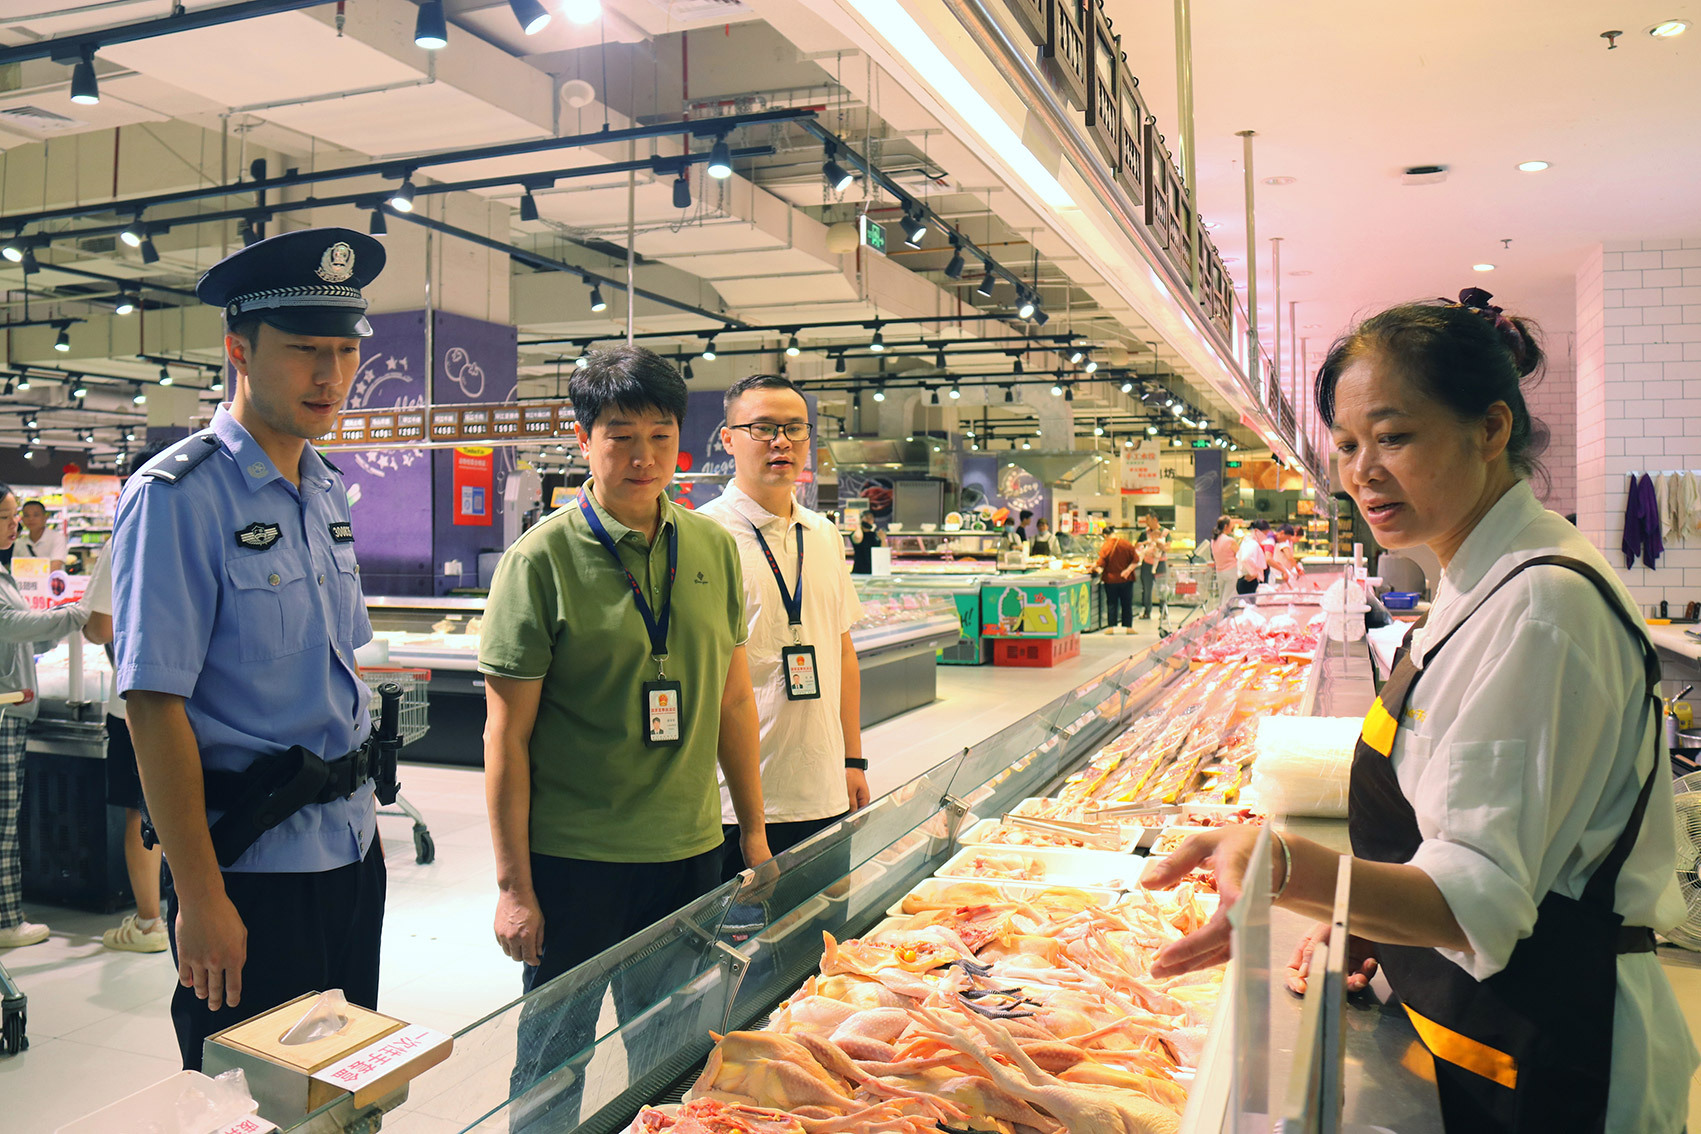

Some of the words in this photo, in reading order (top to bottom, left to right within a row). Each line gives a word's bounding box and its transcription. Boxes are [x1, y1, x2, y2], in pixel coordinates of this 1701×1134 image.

[330, 1031, 429, 1083] 一次性手套盒
